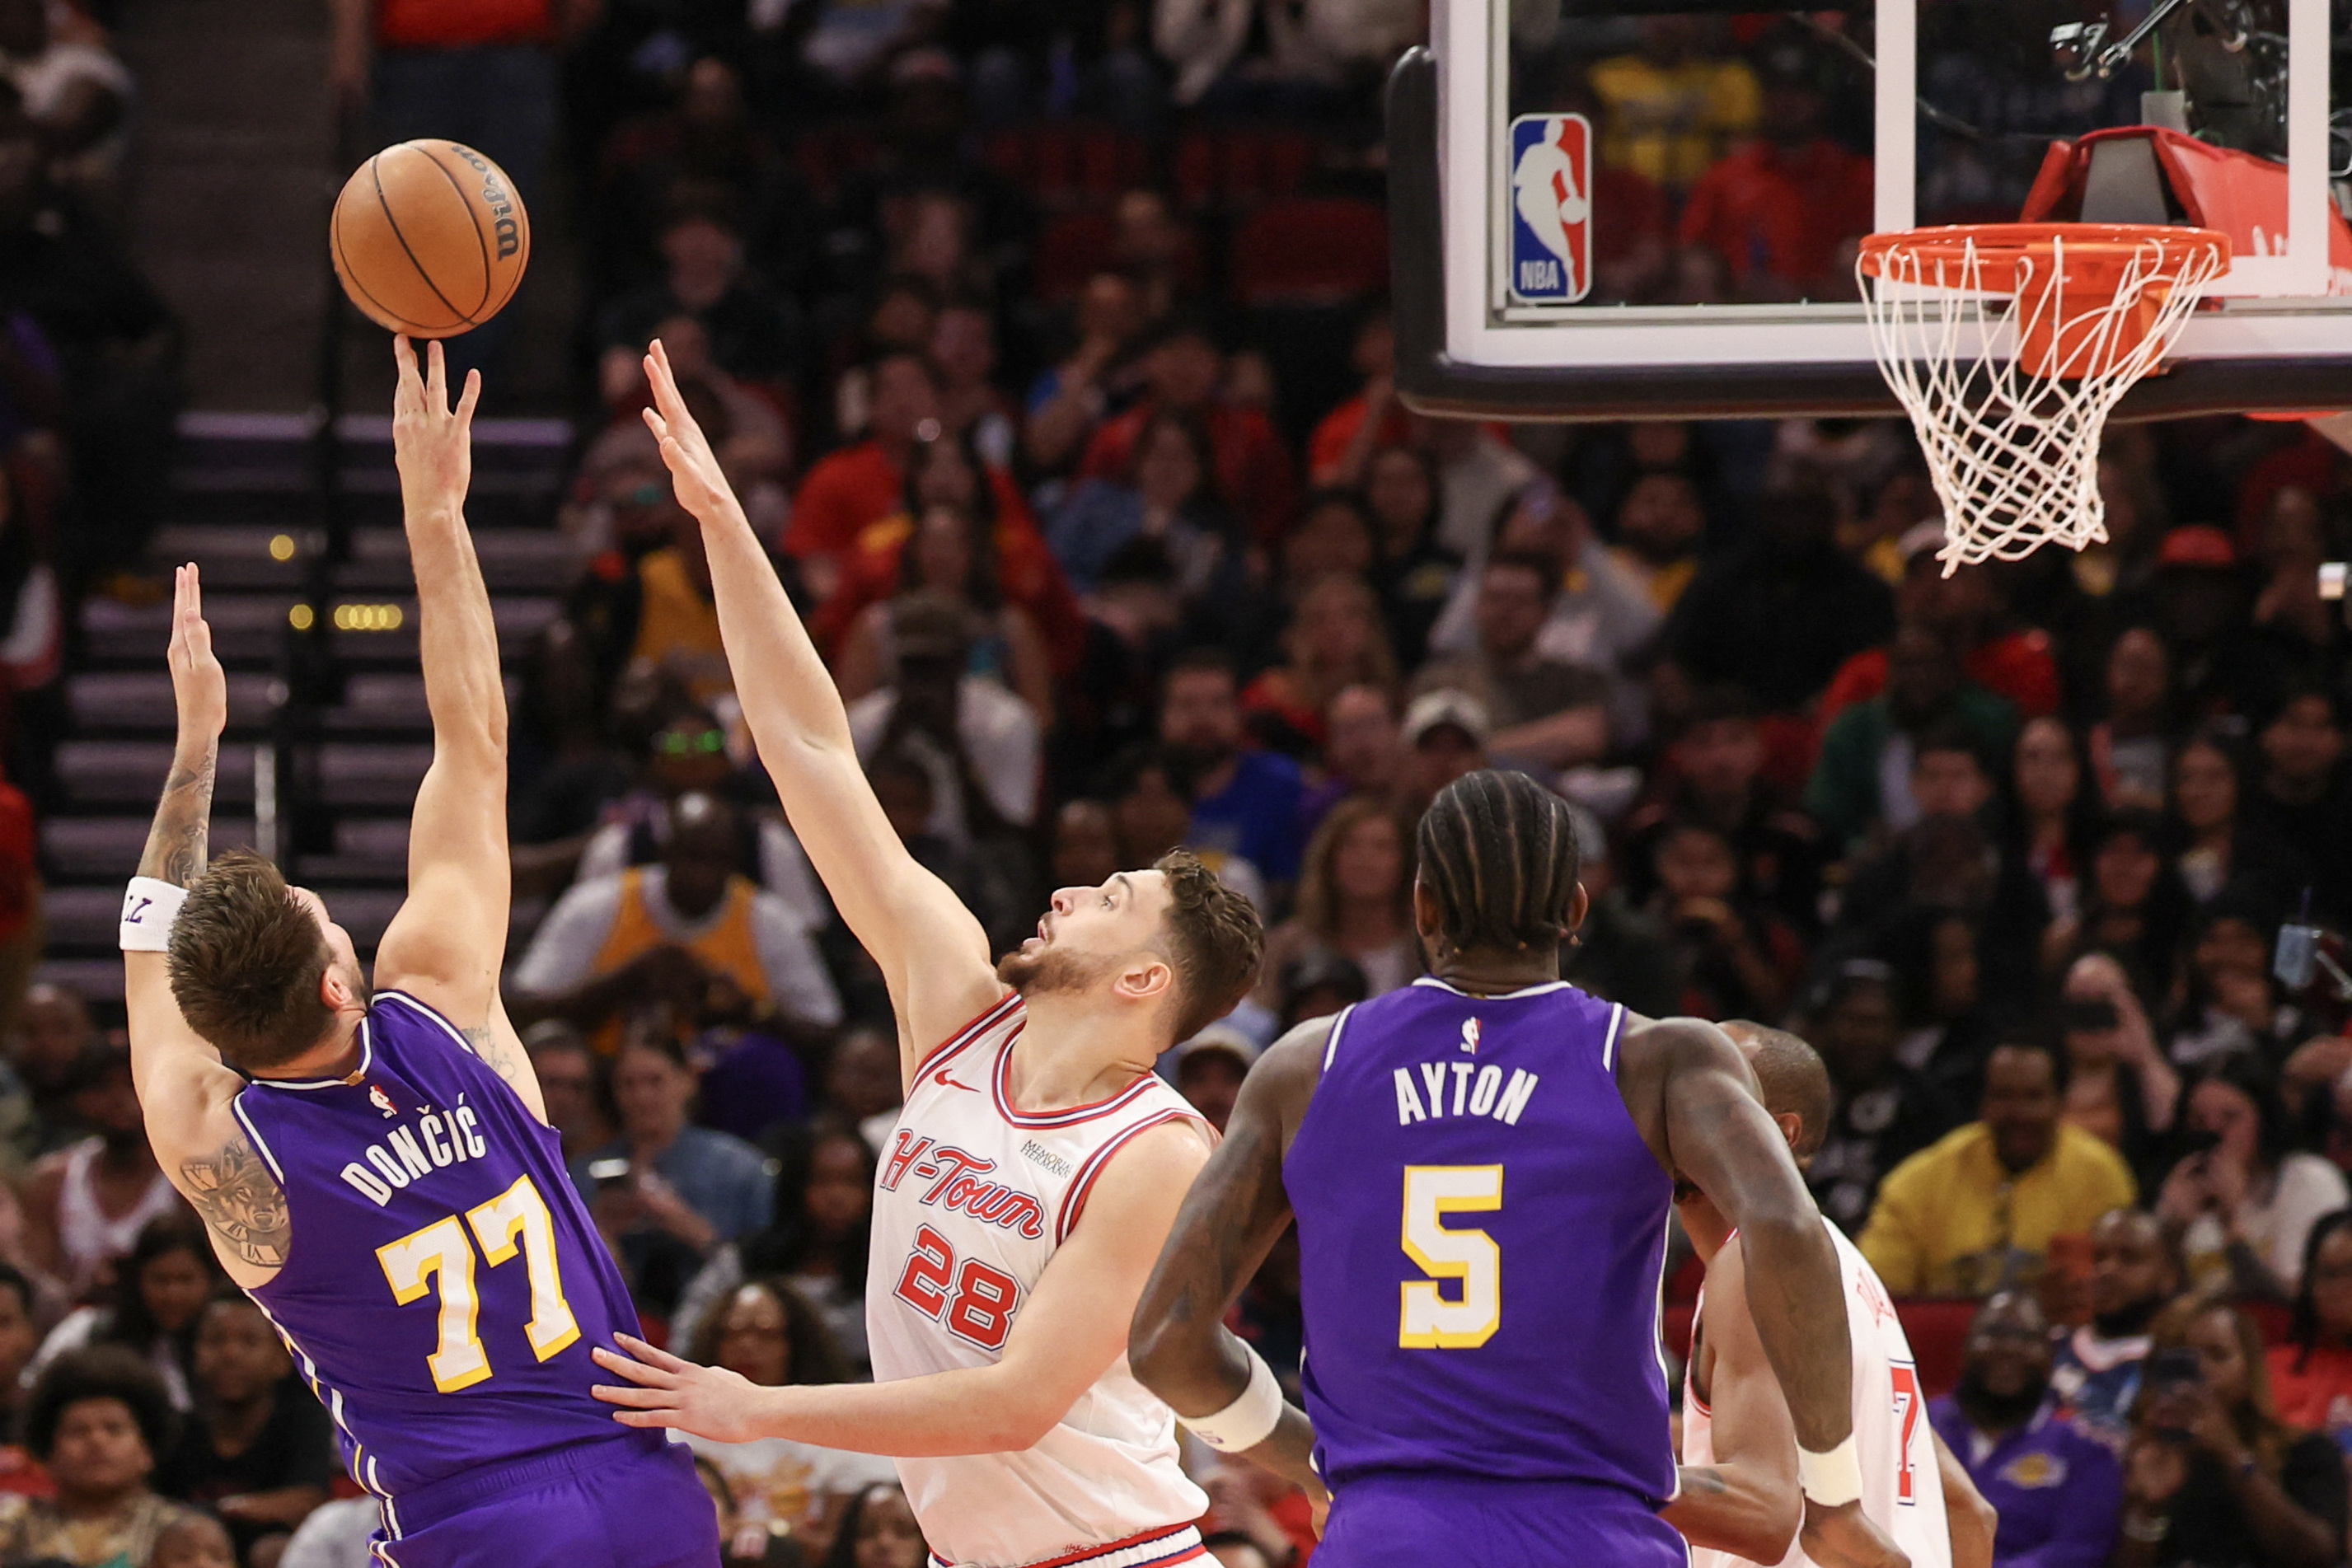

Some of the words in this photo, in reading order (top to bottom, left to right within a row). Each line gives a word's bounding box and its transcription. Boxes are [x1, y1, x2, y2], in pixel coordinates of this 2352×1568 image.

[1520, 260, 1560, 290] NBA
[340, 1092, 486, 1208] DONČIĆ
[1393, 1061, 1539, 1126] AYTON
[879, 1128, 1044, 1240] H-Town
[374, 1172, 582, 1393] 77
[893, 1222, 1022, 1352] 28
[1399, 1163, 1504, 1349] 5
[1887, 1358, 1923, 1507] 7
